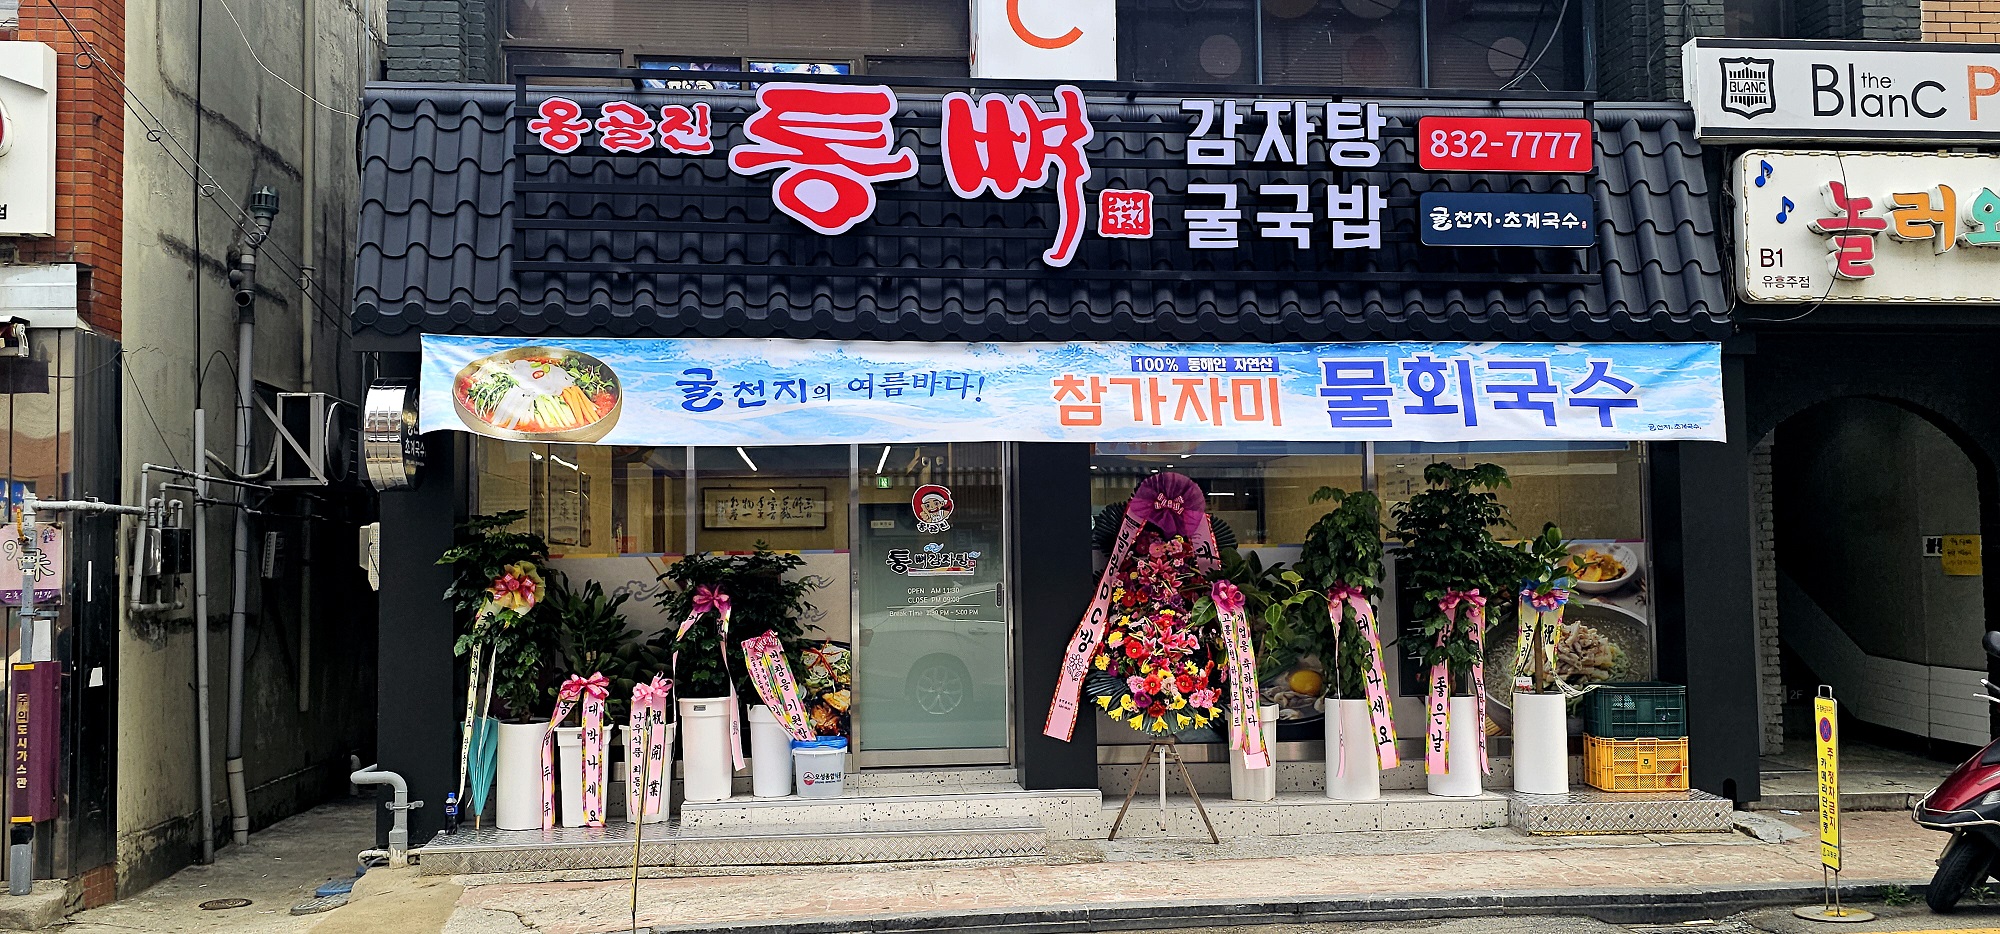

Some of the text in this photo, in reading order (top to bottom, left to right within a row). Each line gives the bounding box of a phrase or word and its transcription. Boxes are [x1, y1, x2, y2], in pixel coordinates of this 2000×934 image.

[1729, 81, 1767, 94] BLANC
[1861, 72, 1893, 89] the
[529, 97, 713, 156] 옹골진
[1182, 100, 1387, 167] 감자탕
[1430, 129, 1582, 160] 832-7777
[1184, 184, 1388, 249] 굴국밥
[1760, 248, 1784, 268] B1
[1762, 275, 1811, 289] 유흥주점
[1135, 357, 1273, 372] 100% 동해안 자연산
[847, 370, 986, 403] 여름바다!
[1053, 374, 1282, 427] 참가자미
[1319, 355, 1640, 429] 물회국수
[907, 587, 925, 595] OPEN
[907, 596, 928, 604] CLOSE
[1222, 613, 1236, 661] 고흥농협
[1544, 623, 1555, 645] 祝
[1242, 658, 1257, 727] 축하합니다
[1790, 689, 1803, 699] 2F
[16, 693, 28, 789] 주의 도시가스관
[587, 702, 600, 823] 대박나세요
